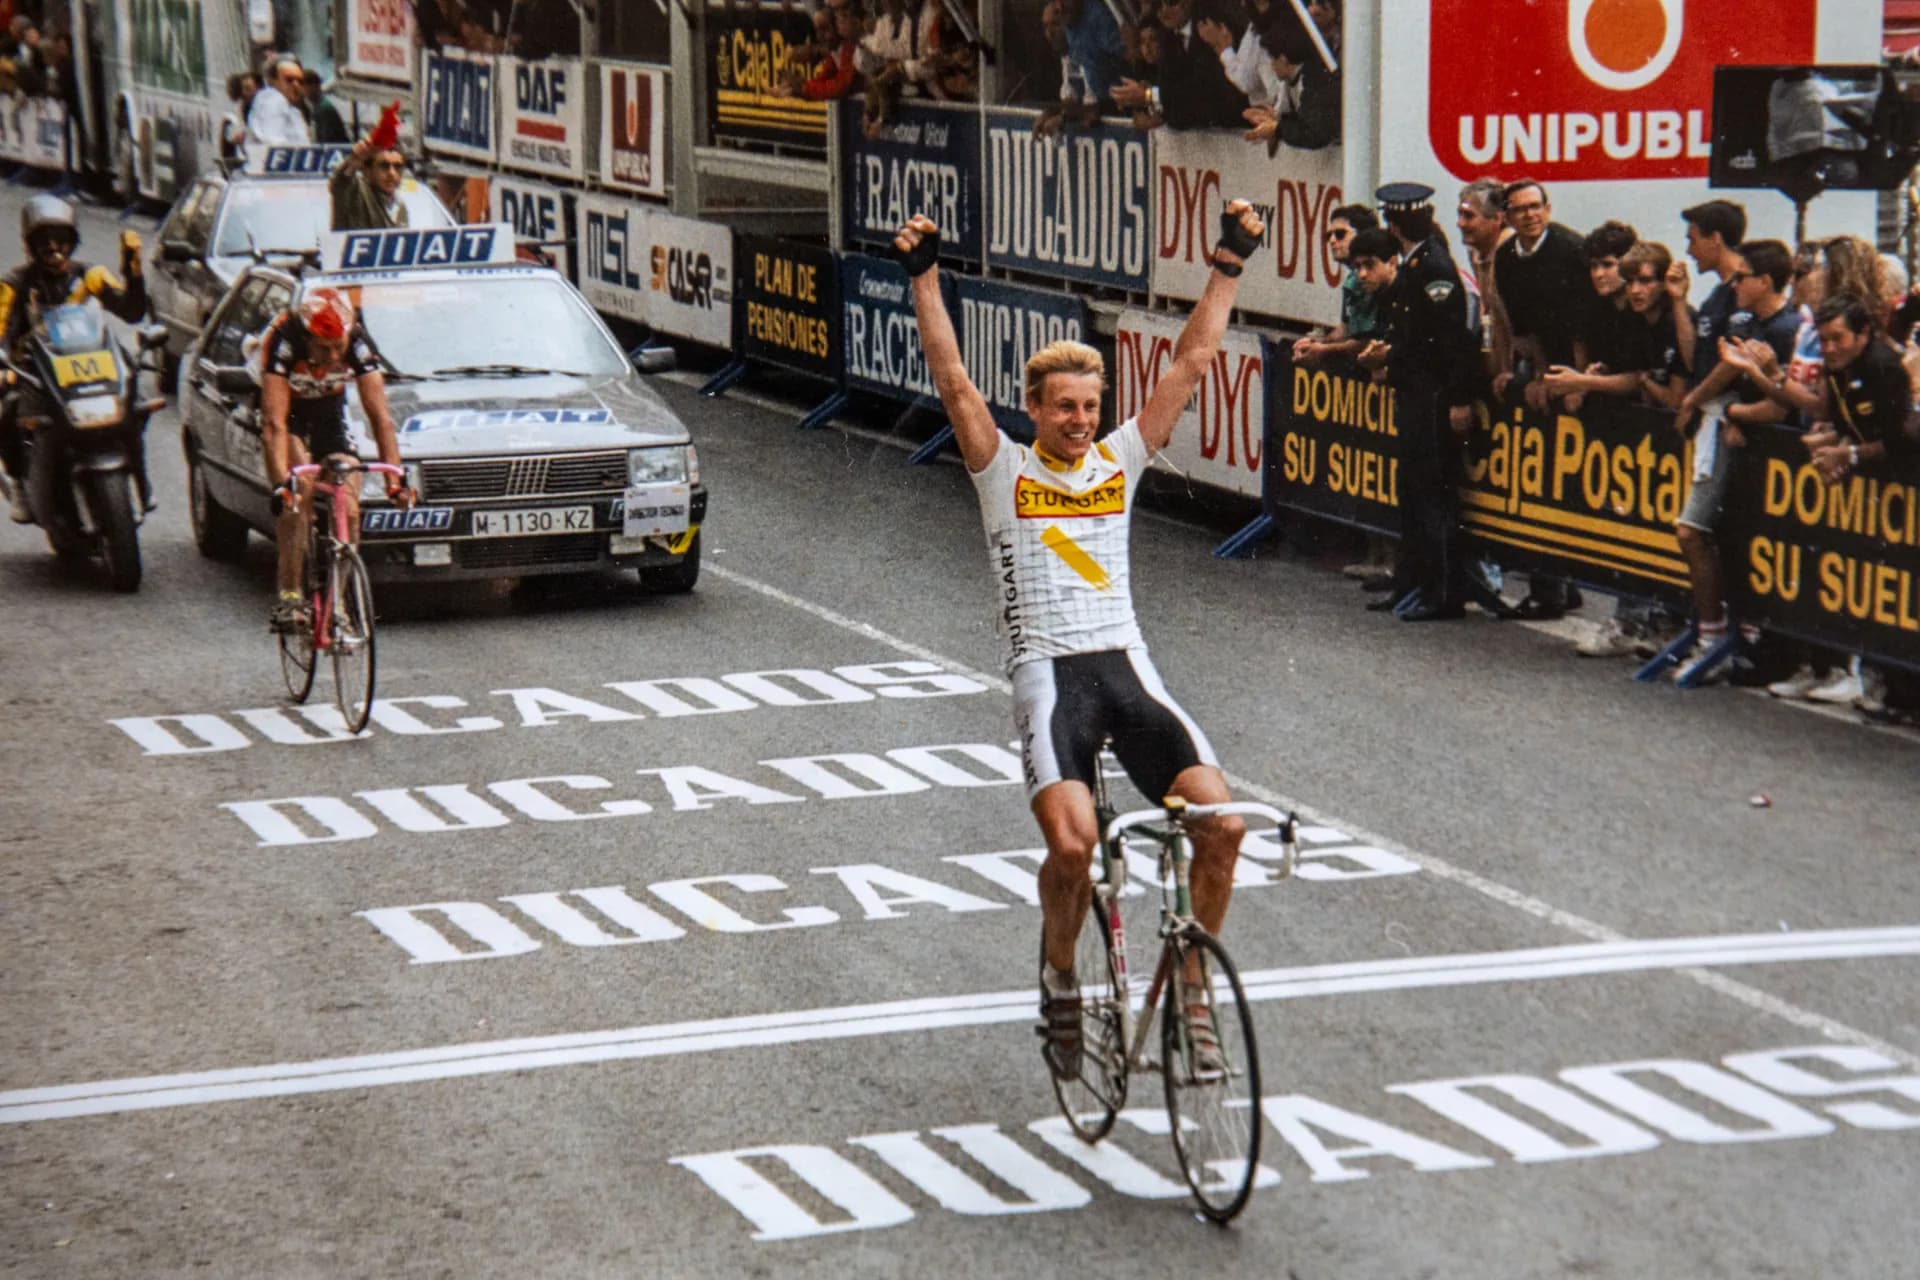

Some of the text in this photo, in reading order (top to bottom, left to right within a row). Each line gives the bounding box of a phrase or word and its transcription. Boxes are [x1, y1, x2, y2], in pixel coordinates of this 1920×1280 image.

[516, 66, 566, 115] DAF
[733, 29, 769, 104] Caja
[429, 67, 489, 137] FIAT
[267, 148, 348, 171] FIA
[1459, 110, 1711, 164] UNIPUBL
[502, 189, 556, 240] DAF
[865, 154, 960, 243] RACER
[990, 129, 1144, 277] DUCADOS
[1159, 165, 1220, 268] DYC
[349, 231, 489, 265] FIAT
[1277, 178, 1342, 288] DYC
[755, 252, 792, 297] PLAN
[798, 263, 817, 304] DE
[747, 300, 829, 358] PENSIONES
[70, 358, 99, 377] M
[1201, 350, 1262, 472] DYC
[1284, 432, 1316, 485] SU
[368, 510, 449, 528] FIAT
[1750, 536, 1800, 600] SU
[107, 661, 989, 756] DUCADOS
[218, 741, 1026, 848] DUCADO
[668, 1045, 1919, 1240] DUCADOS
